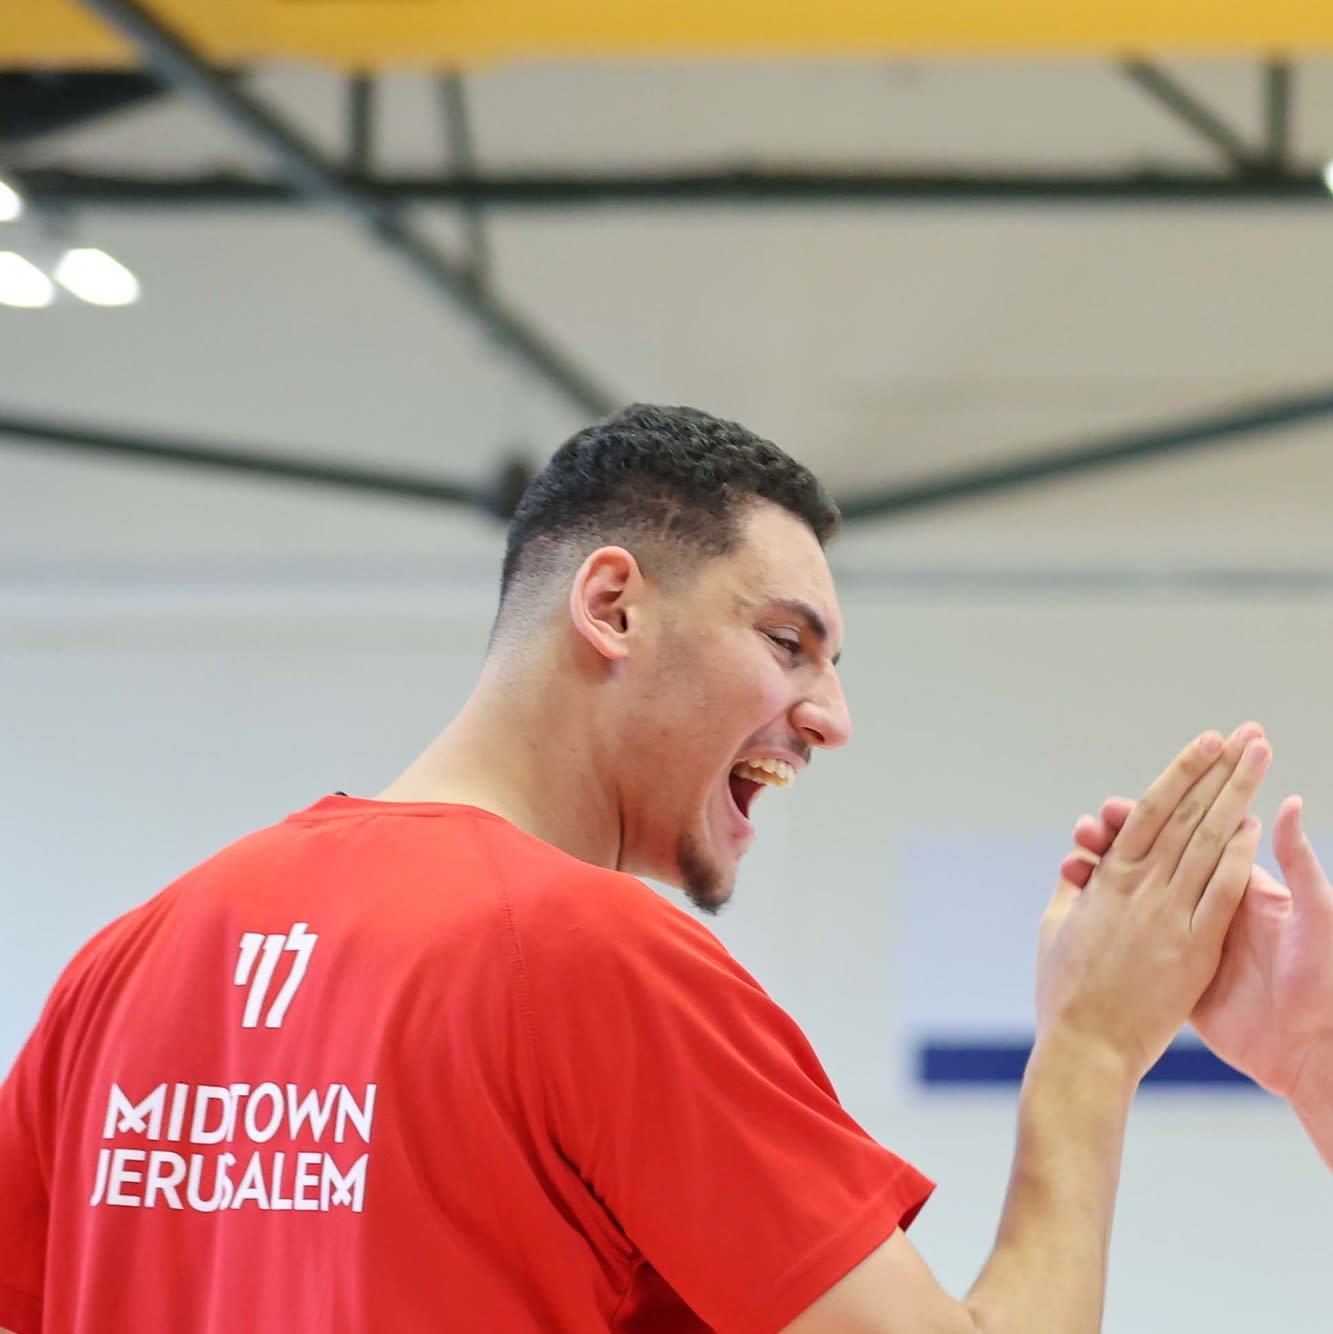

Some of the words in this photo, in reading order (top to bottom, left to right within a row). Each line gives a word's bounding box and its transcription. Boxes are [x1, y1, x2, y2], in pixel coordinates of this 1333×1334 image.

[233, 922, 319, 1029] לוי
[102, 1082, 377, 1144] MIDTOWN
[90, 1148, 369, 1213] JERUSALEM
